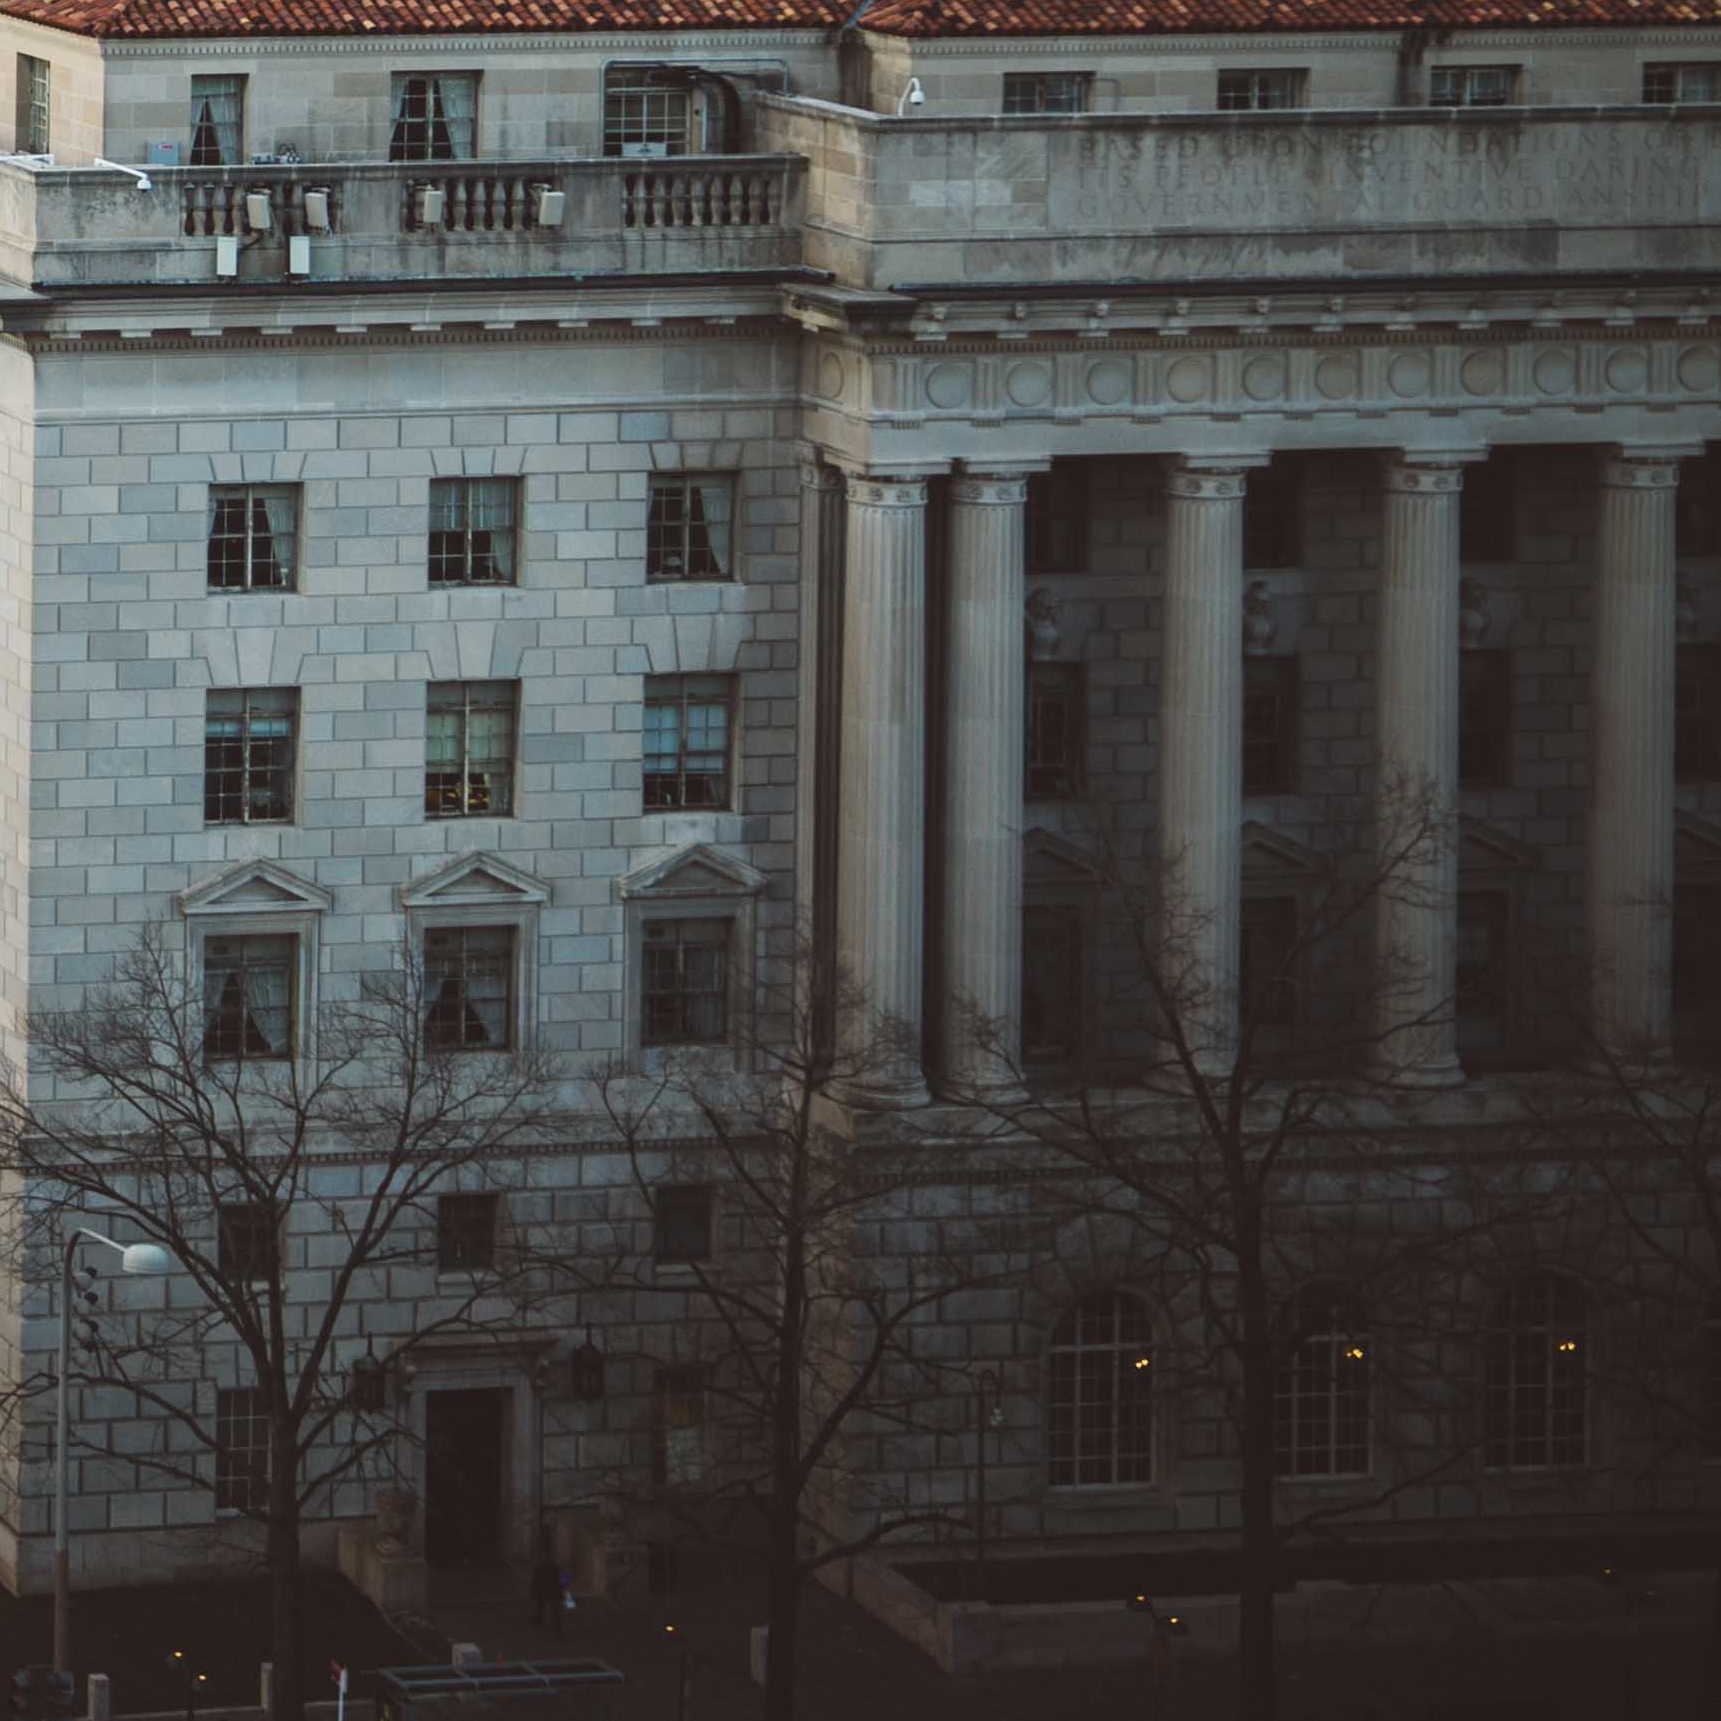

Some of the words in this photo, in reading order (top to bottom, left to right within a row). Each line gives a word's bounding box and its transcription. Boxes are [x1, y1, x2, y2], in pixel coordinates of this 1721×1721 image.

[1222, 133, 1324, 157] UPON
[1077, 165, 1133, 189] ITS
[1155, 163, 1292, 188] PEOPLE
[1326, 158, 1533, 184] INVENTIVE
[1555, 154, 1700, 181] DARING
